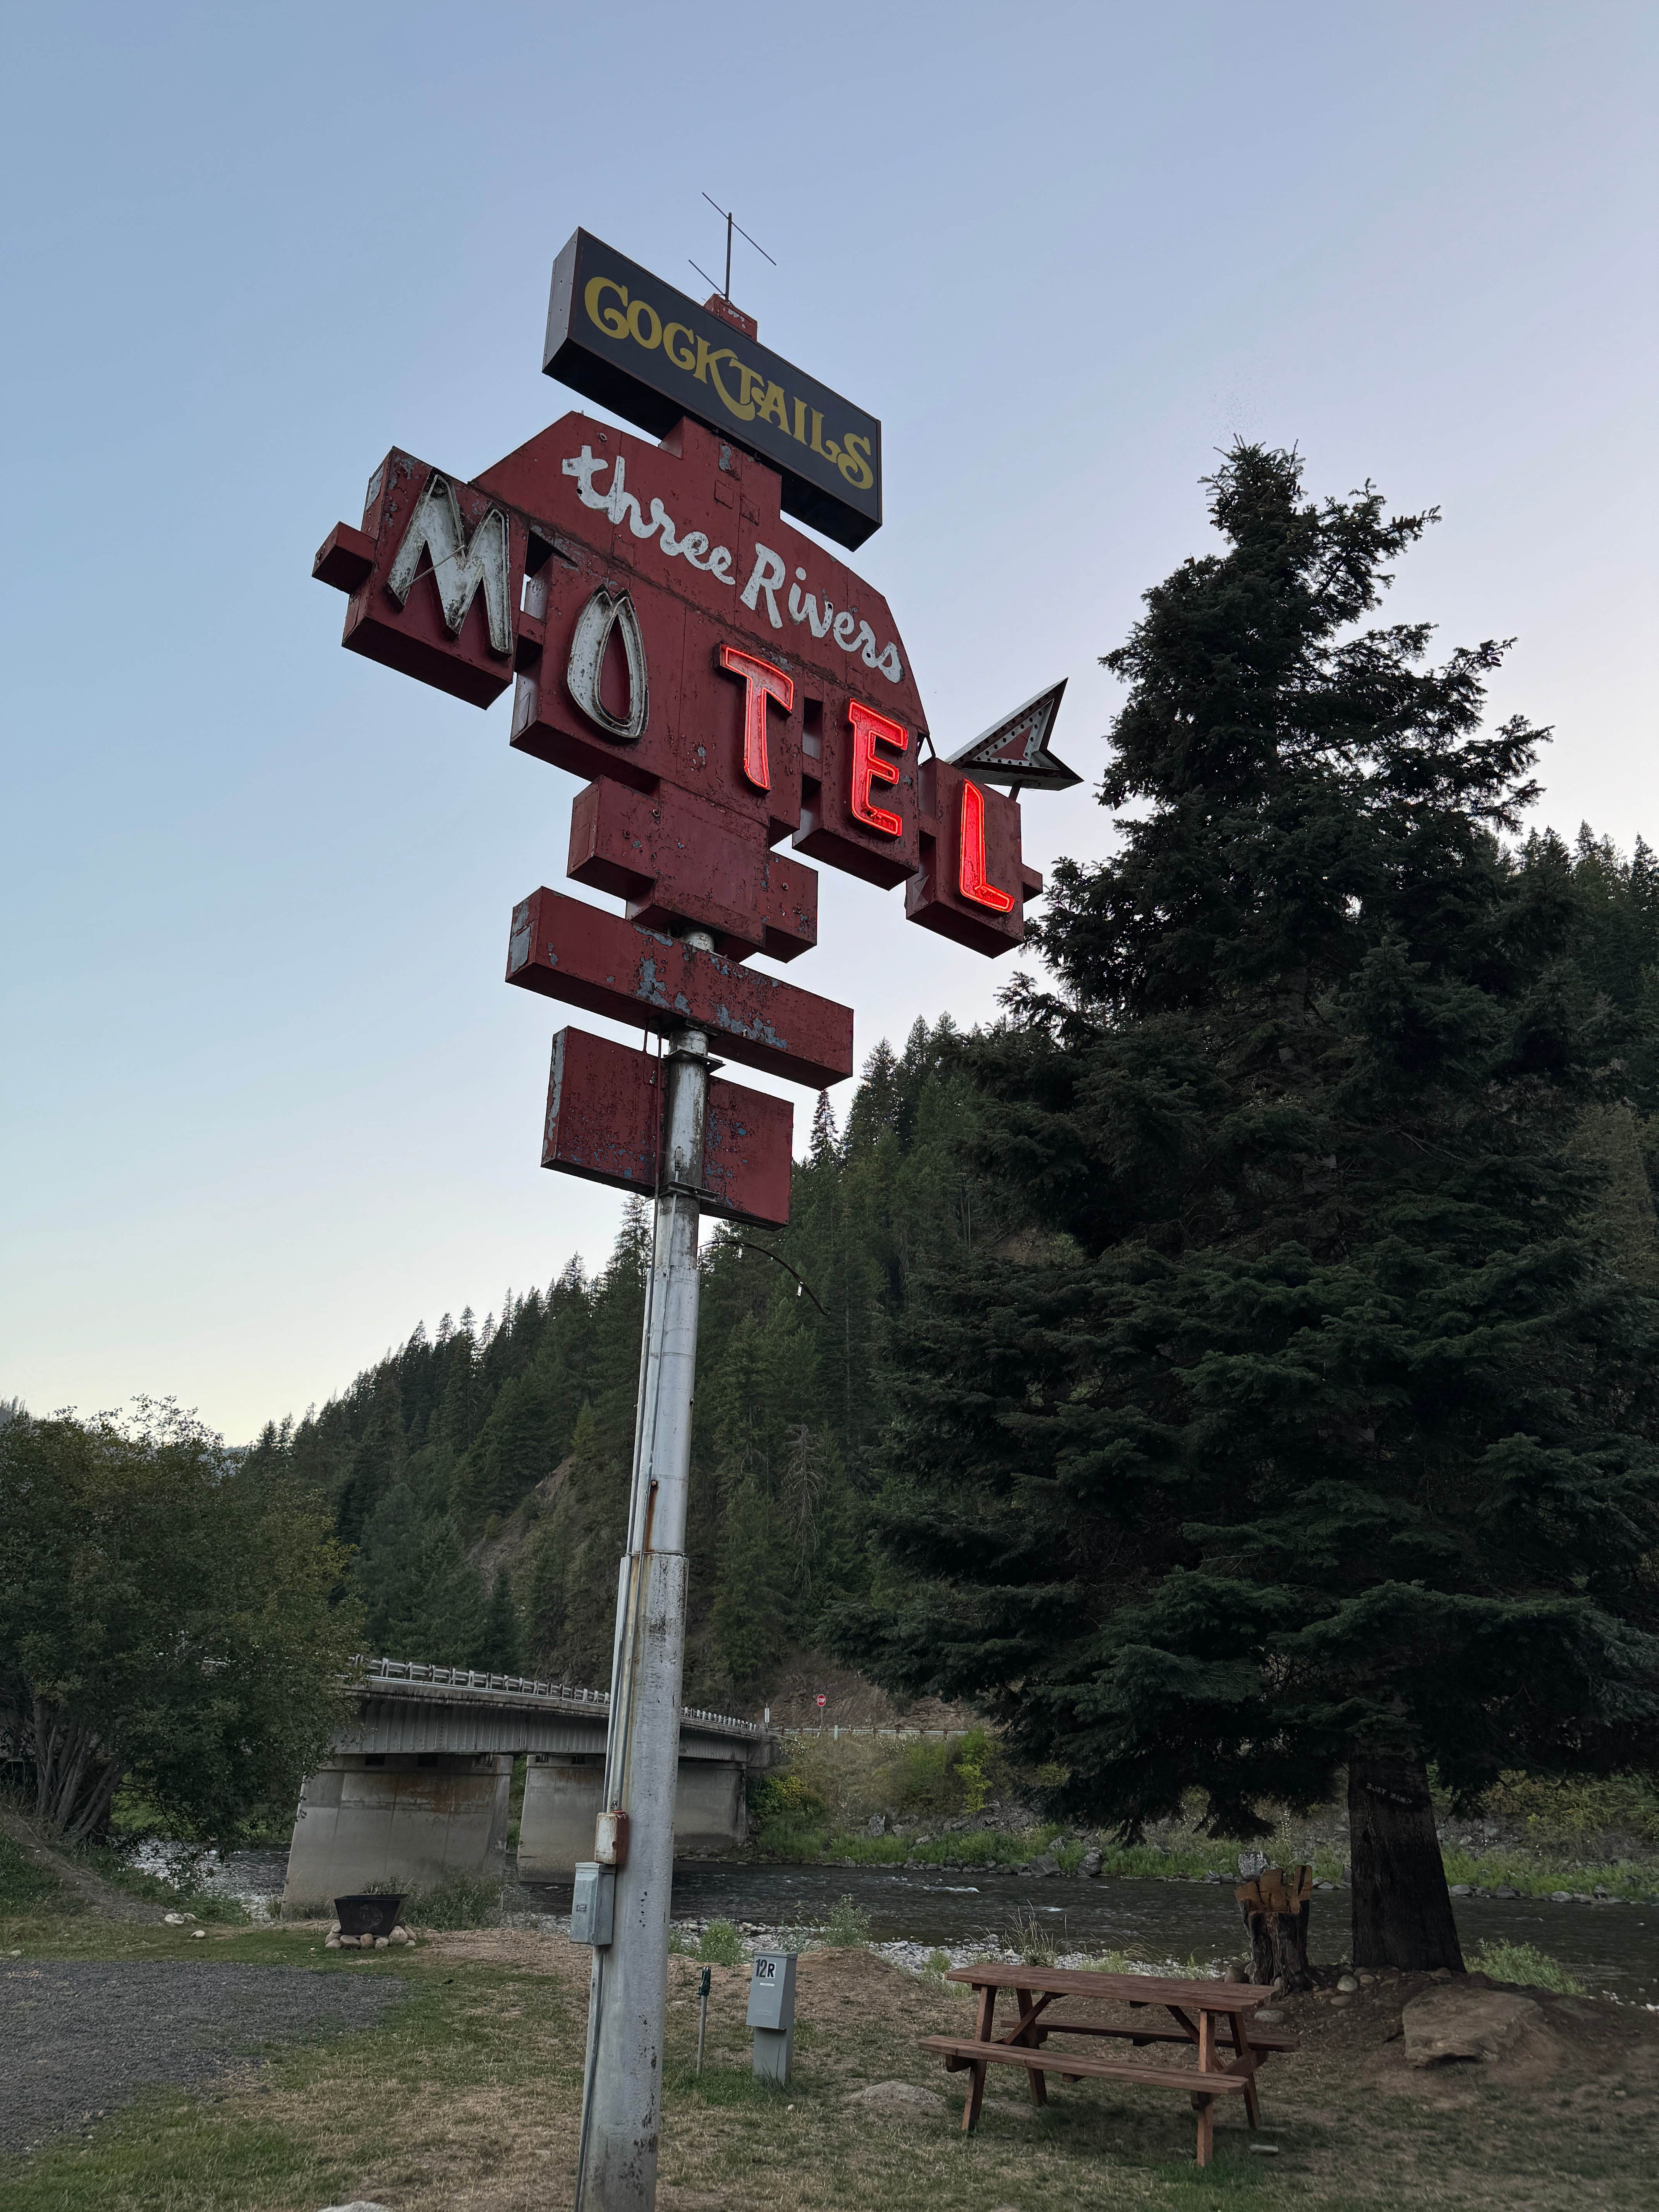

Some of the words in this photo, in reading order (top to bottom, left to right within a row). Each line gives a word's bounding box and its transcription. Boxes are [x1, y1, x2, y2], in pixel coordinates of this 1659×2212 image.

[562, 445, 735, 585] three
[740, 542, 904, 683] Rivers
[388, 467, 1014, 913] MOTEL
[756, 1959, 775, 1977] 12R
